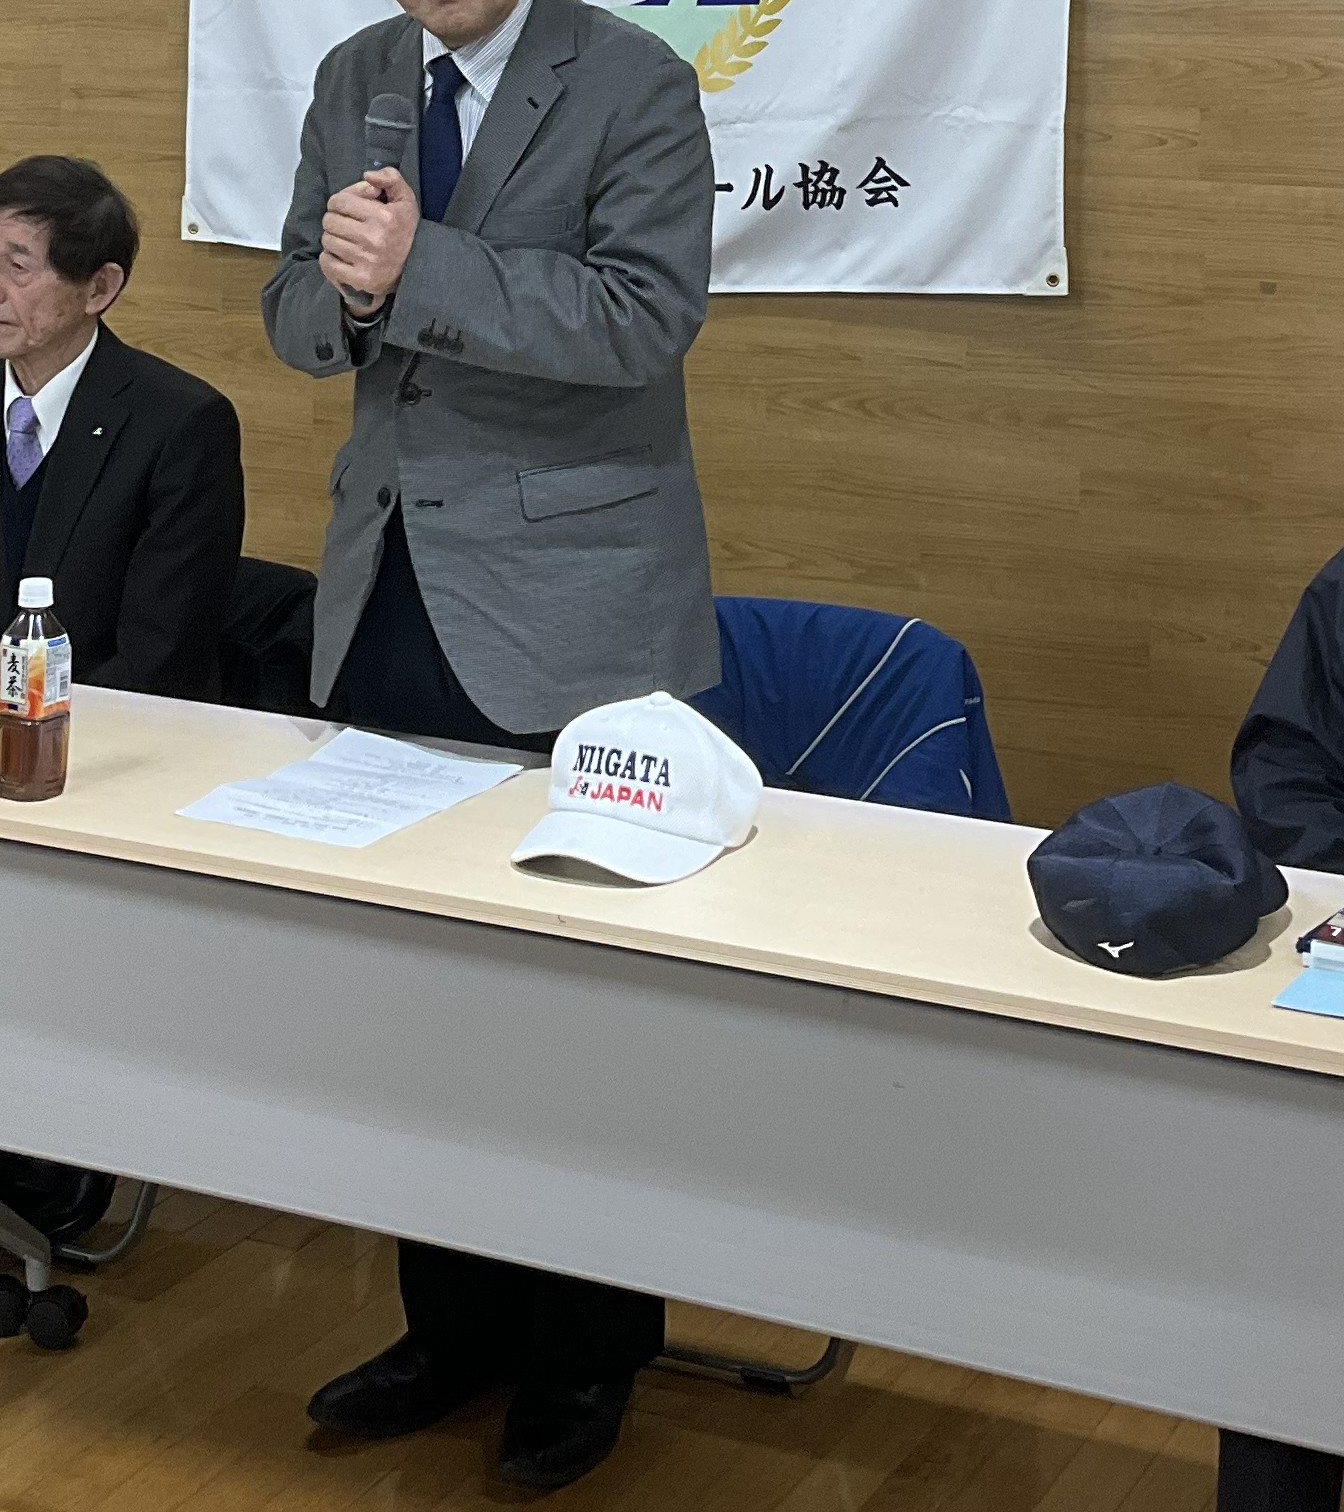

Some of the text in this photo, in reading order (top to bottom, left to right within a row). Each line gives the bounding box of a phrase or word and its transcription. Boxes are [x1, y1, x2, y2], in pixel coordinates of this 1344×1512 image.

[5, 652, 23, 698] 麦茶
[572, 743, 672, 788] NIIGATA
[590, 783, 665, 812] JAPAN
